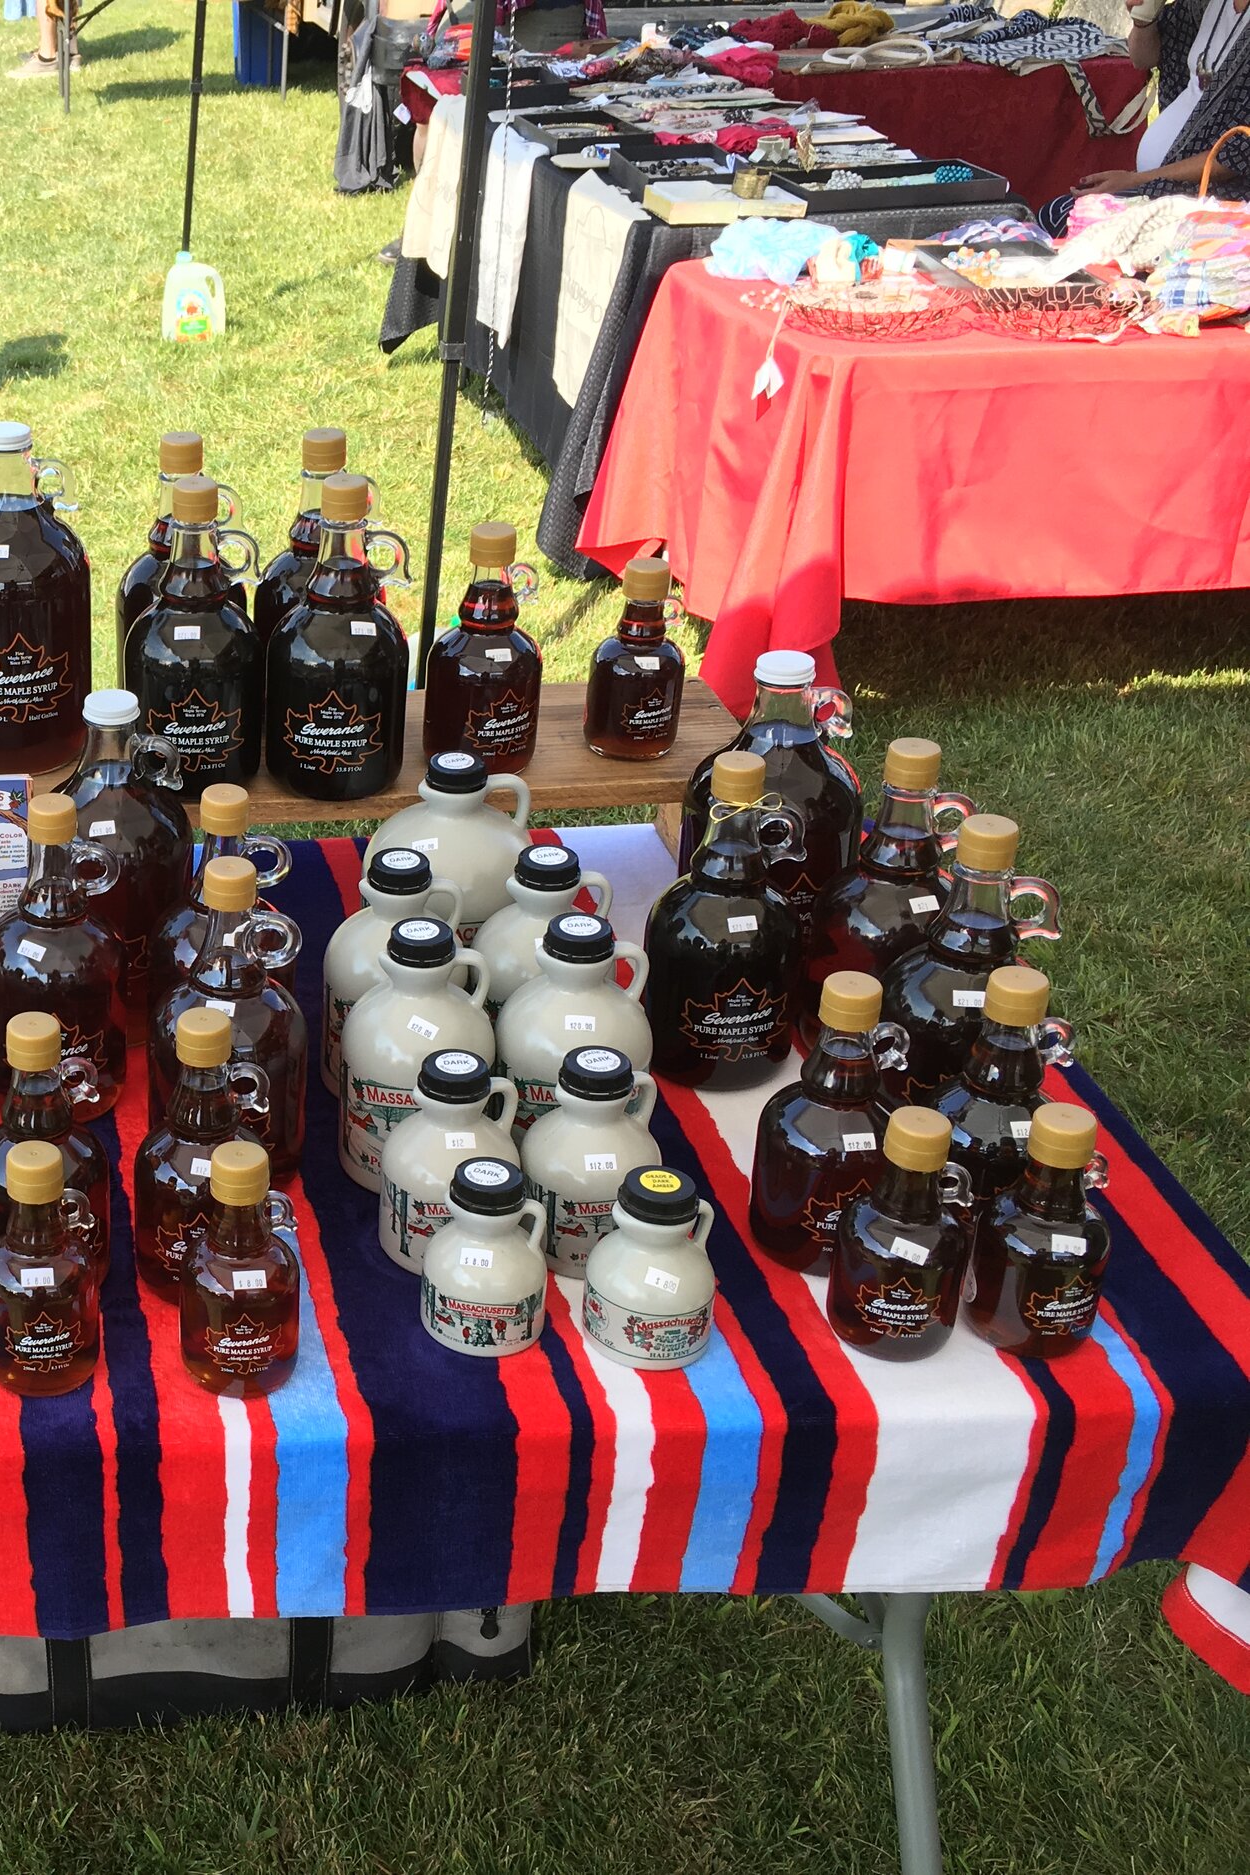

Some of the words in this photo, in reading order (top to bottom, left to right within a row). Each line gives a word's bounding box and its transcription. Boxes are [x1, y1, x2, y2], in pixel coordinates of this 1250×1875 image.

[4, 687, 32, 696] MAPLE
[33, 682, 58, 694] SYRUP
[634, 705, 672, 719] Severance
[483, 711, 530, 730] Severance
[163, 720, 226, 734] Severance
[300, 722, 365, 736] Severance
[495, 728, 514, 736] MAPLE
[204, 735, 230, 745] SYRUP
[294, 734, 313, 746] PURE
[314, 738, 340, 747] MAPLE
[342, 739, 368, 748] SYRUP
[445, 757, 466, 765] DARK
[958, 998, 982, 1006] $21.00
[702, 1008, 772, 1025] Severance
[411, 1023, 432, 1038] $20.00
[570, 1022, 593, 1030] $20.00
[694, 1025, 717, 1035] PURE
[749, 1022, 774, 1034] SYRUP
[585, 1055, 611, 1064] DARK
[848, 1141, 871, 1149] $12.00
[590, 1162, 613, 1170] $12.00
[473, 1167, 500, 1178] DARK
[472, 1258, 489, 1267] 8.00
[247, 1279, 263, 1287] 8.00
[655, 1276, 660, 1285] $
[448, 1300, 514, 1315] MASSACHUSETTS
[871, 1298, 928, 1310] Severance
[1044, 1294, 1094, 1310] Severance
[865, 1304, 882, 1315] PURE
[883, 1311, 906, 1320] MAPLE
[20, 1332, 70, 1346] Severance
[218, 1335, 270, 1347] Severance
[15, 1345, 31, 1353] PURE
[55, 1342, 73, 1352] SYRUP
[213, 1346, 230, 1354] PURE
[253, 1346, 272, 1354] SYRUP
